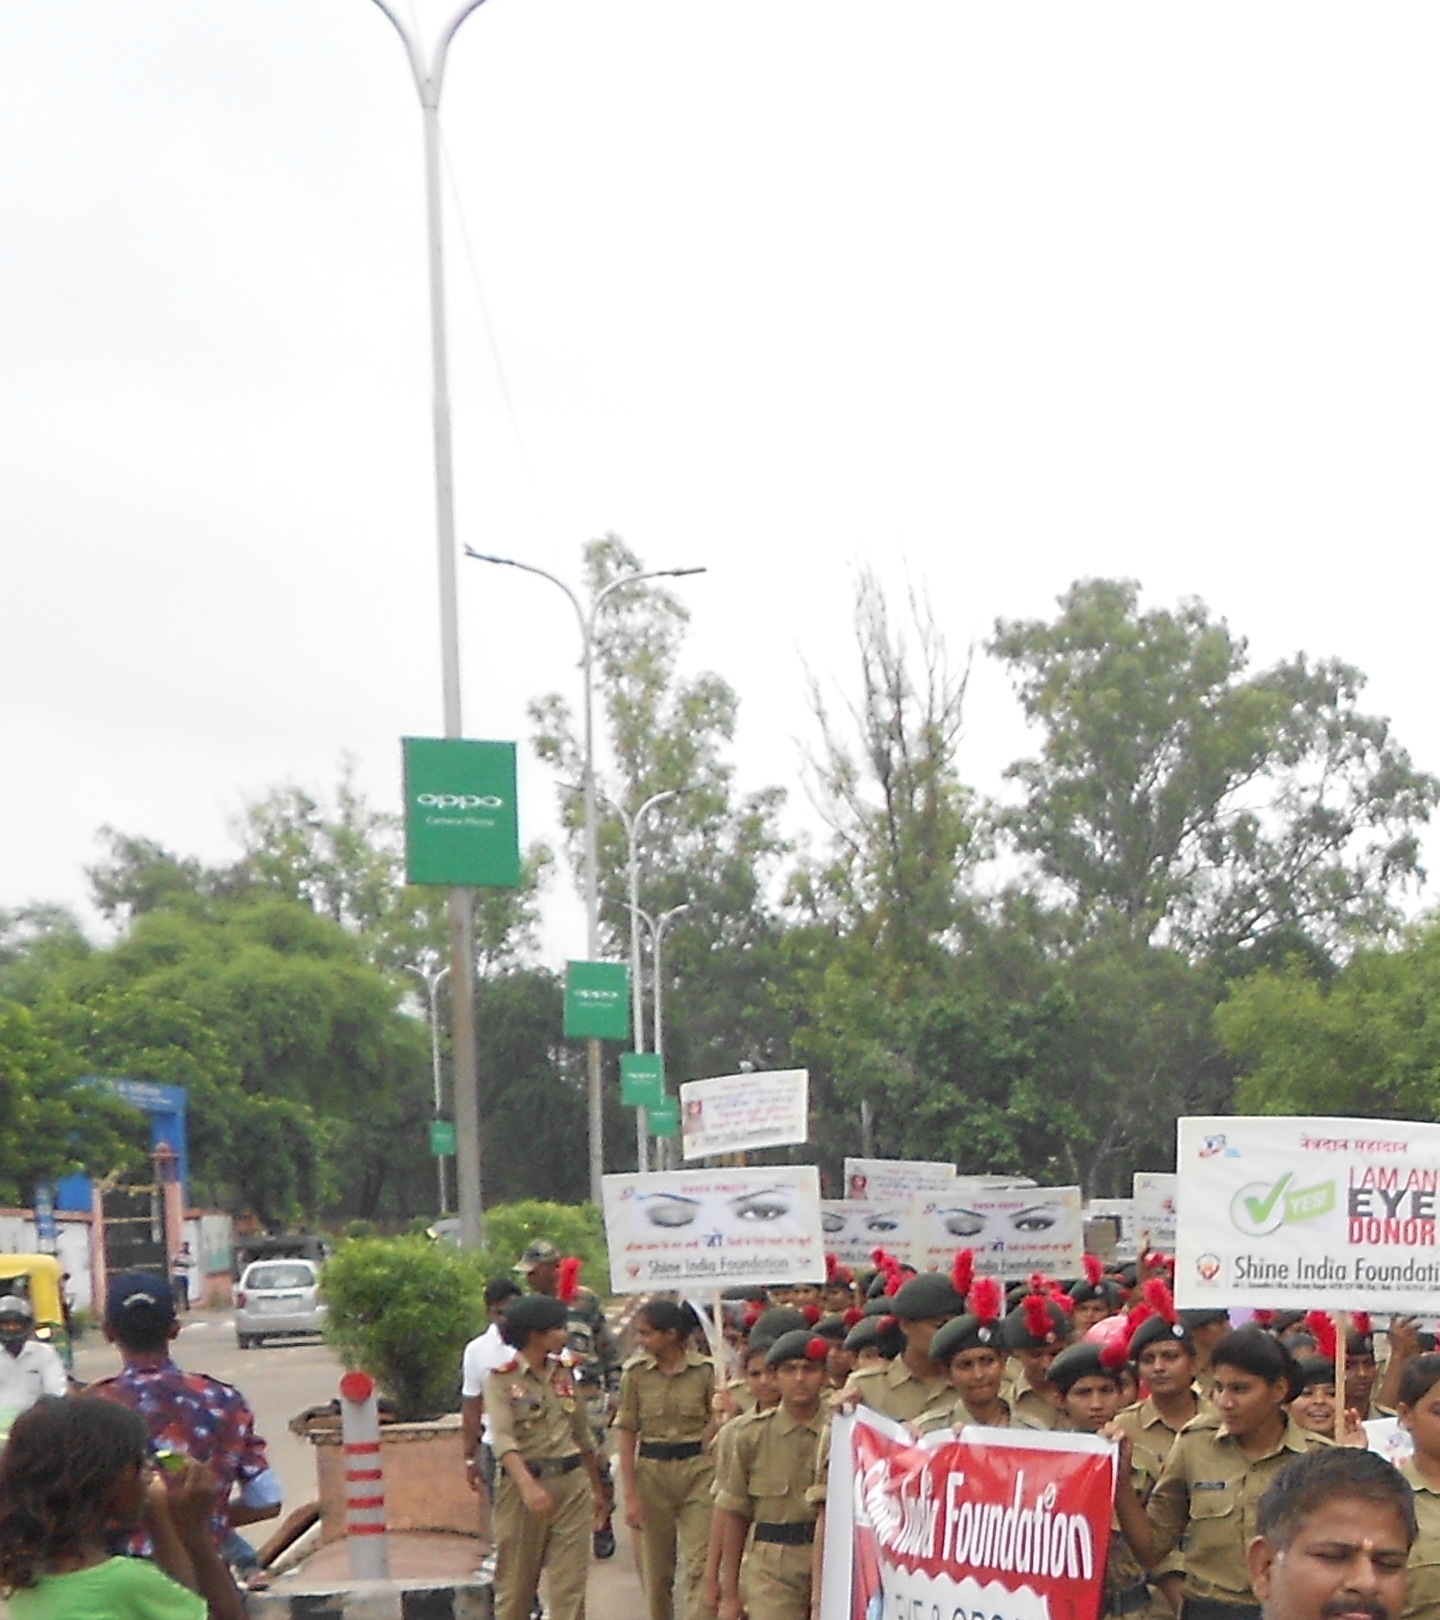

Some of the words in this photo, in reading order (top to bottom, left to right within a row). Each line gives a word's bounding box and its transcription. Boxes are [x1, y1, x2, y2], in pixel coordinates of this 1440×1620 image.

[1361, 1166, 1399, 1190] AM
[1406, 1168, 1438, 1191] AN
[1348, 1187, 1437, 1219] EYE
[1348, 1217, 1436, 1246] DONOR
[1234, 1254, 1289, 1280] Shine
[1297, 1255, 1347, 1281] India
[942, 1469, 1093, 1580] Foundation
